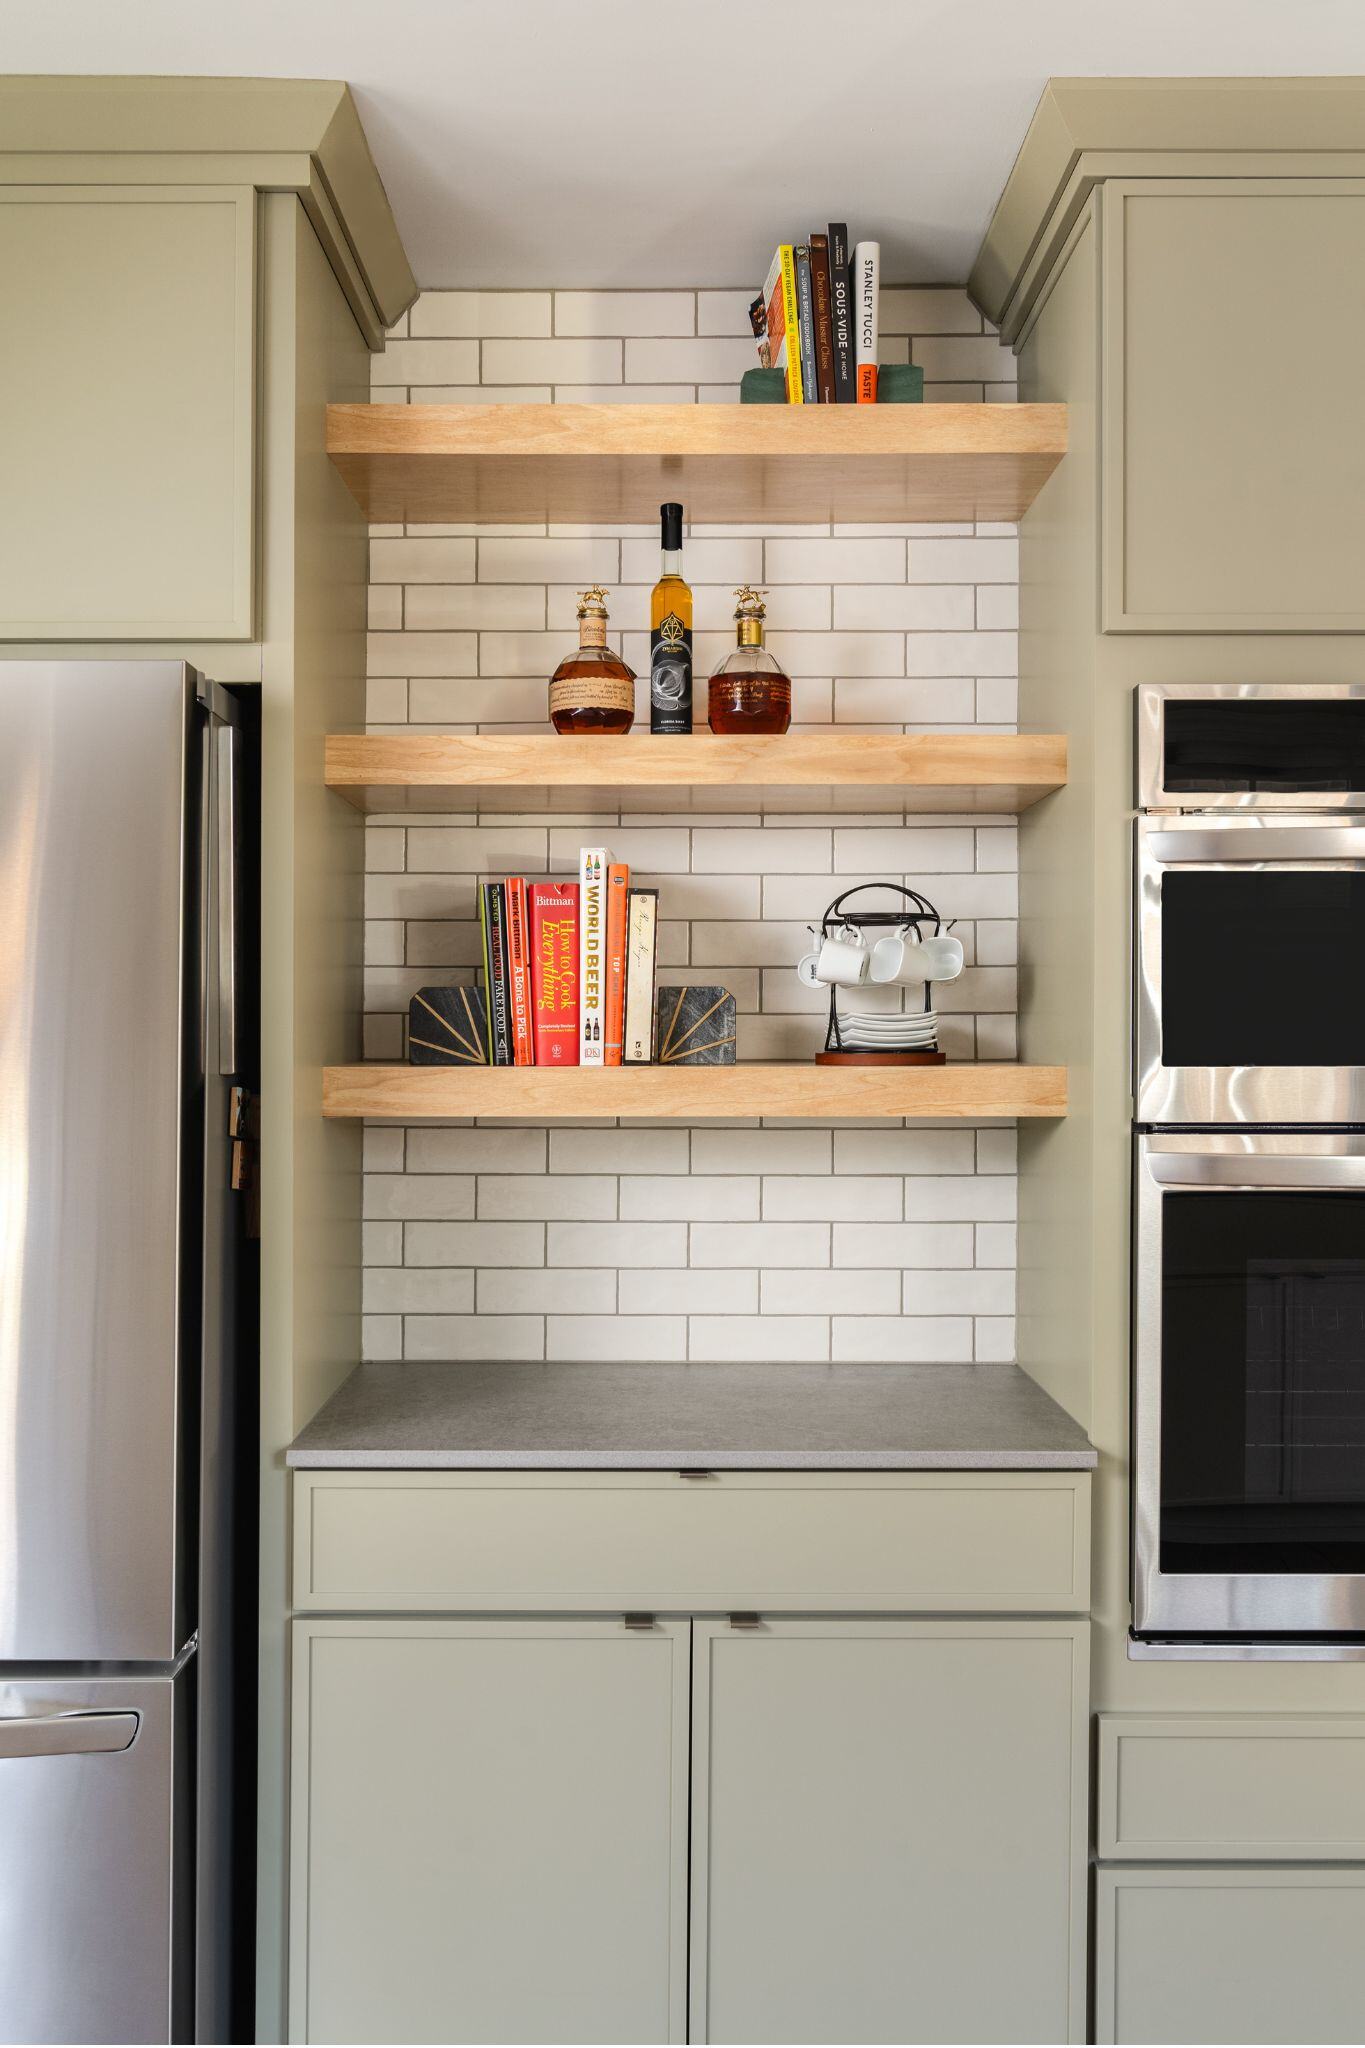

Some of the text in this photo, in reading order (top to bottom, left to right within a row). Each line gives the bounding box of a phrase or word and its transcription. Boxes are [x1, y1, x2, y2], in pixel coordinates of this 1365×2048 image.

[785, 279, 793, 296] VEGAN
[786, 296, 795, 324] CHALLENGE
[863, 259, 873, 348] STANLEY TUCCI
[816, 271, 830, 369] Chocolate Master Class
[804, 322, 812, 355] COOKBOOK
[840, 351, 847, 360] AT
[863, 369, 872, 399] TASTE
[491, 889, 499, 921] OLMSTED
[511, 891, 520, 917] Mark
[536, 895, 574, 906] Bittman
[512, 920, 521, 959] Bittman
[584, 885, 600, 1010] WORLD BEER
[537, 919, 560, 1011] Everything
[559, 919, 577, 1009] How to Cook
[612, 956, 620, 973] TOP
[492, 926, 506, 1033] REAL FOOD FAKE FOOD
[515, 976, 525, 1003] Bone
[516, 1005, 525, 1015] to
[517, 1017, 527, 1039] Pick
[585, 1048, 600, 1058] DK
